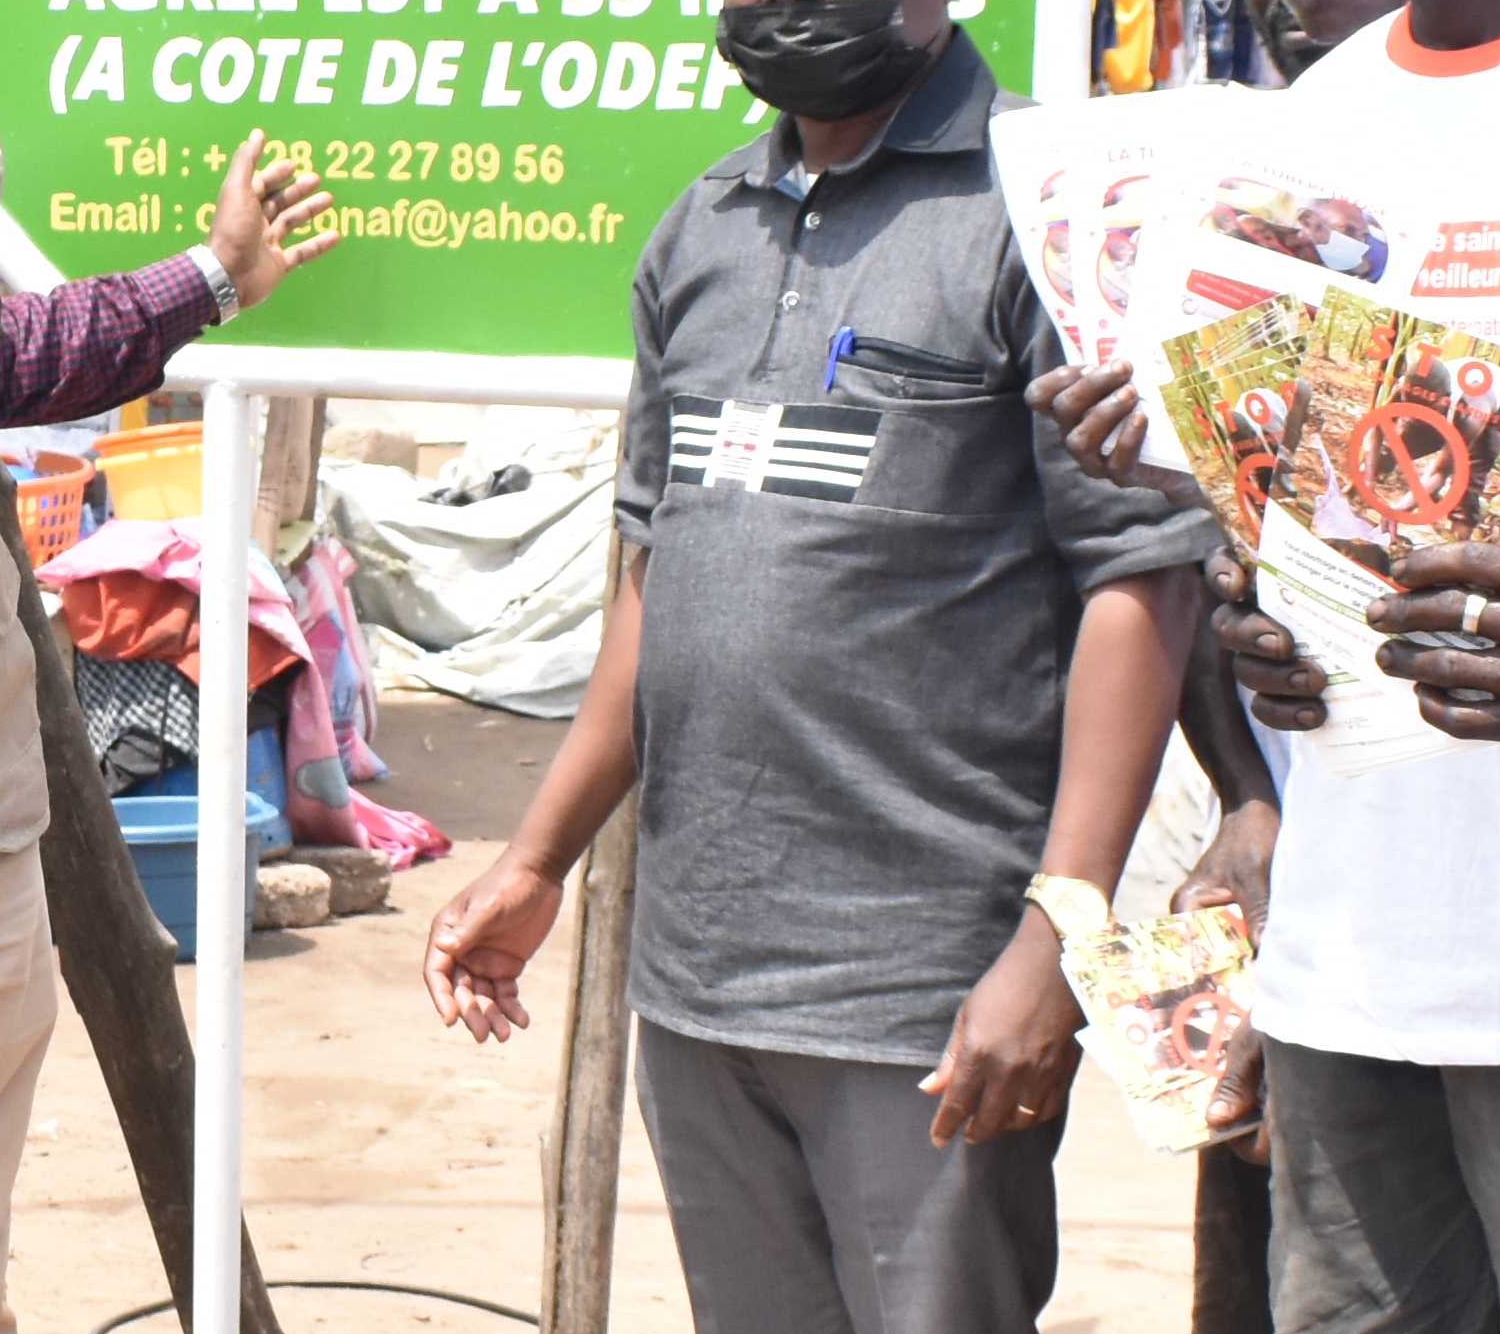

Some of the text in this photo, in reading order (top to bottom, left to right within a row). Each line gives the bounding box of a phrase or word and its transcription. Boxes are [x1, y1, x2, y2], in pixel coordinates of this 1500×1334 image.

[49, 34, 124, 113] (A
[152, 37, 343, 104] COTE
[362, 40, 464, 106] DE
[106, 136, 166, 176] Tél
[240, 140, 313, 179] 28
[326, 141, 375, 179] 22
[389, 141, 439, 180] 27
[450, 143, 500, 181] 89
[514, 144, 564, 183] 56
[49, 193, 161, 233] Email
[197, 200, 623, 249] onaf@yahoo.fr
